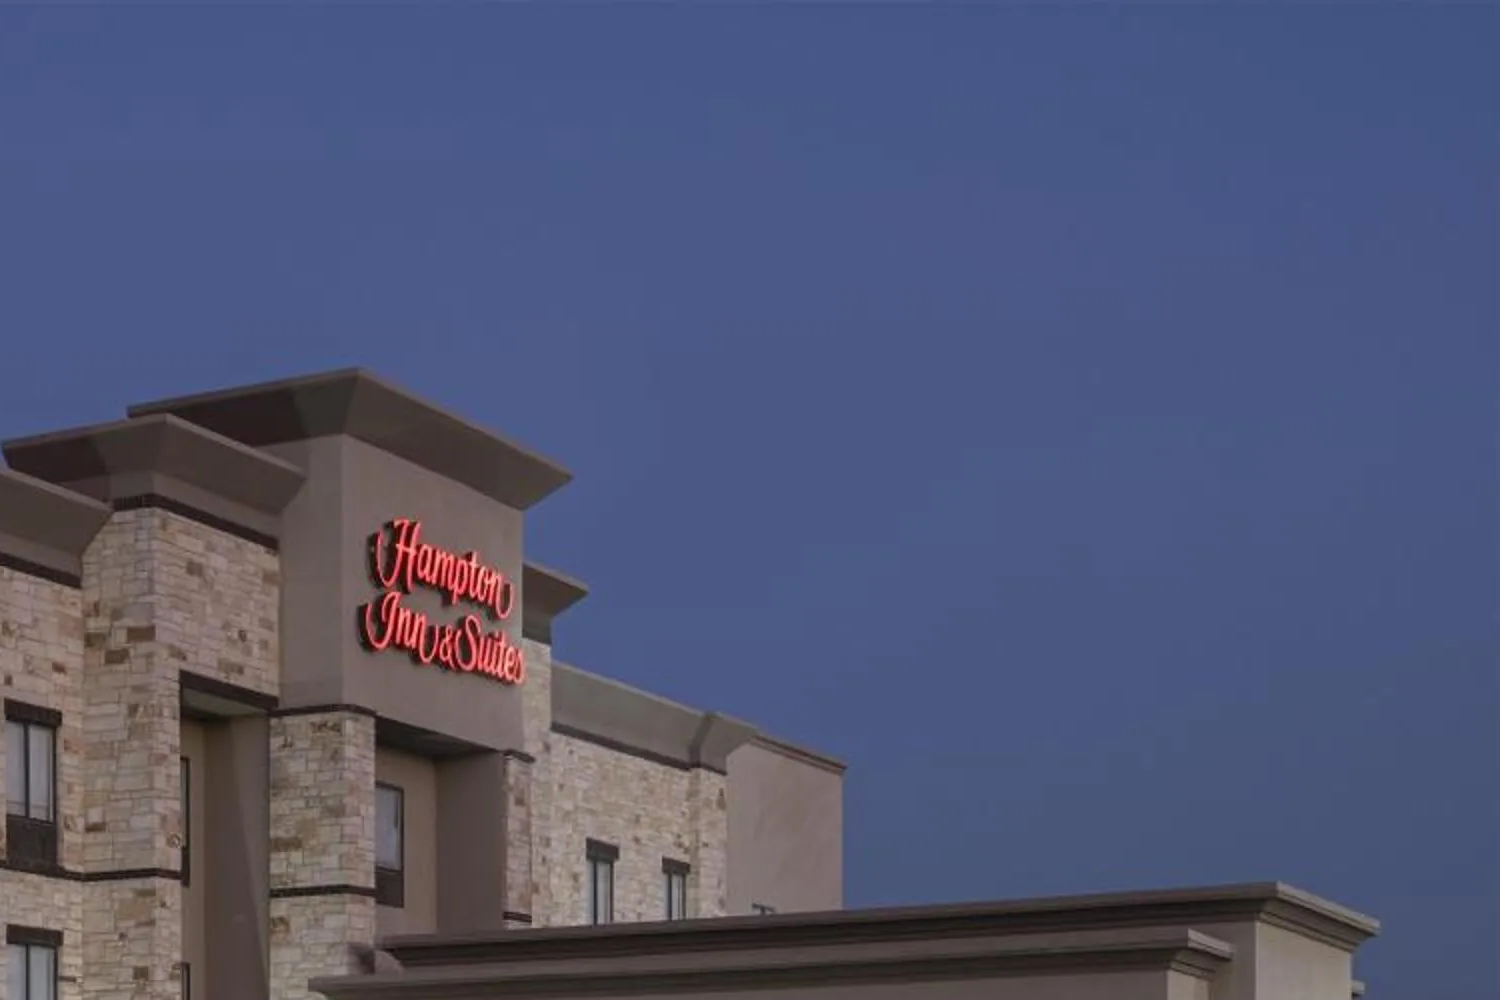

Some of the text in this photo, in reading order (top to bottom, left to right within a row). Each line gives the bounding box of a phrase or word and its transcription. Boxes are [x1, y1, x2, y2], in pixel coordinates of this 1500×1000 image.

[376, 516, 514, 620] Hampton
[366, 591, 440, 664] Inn
[455, 614, 526, 685] Suites
